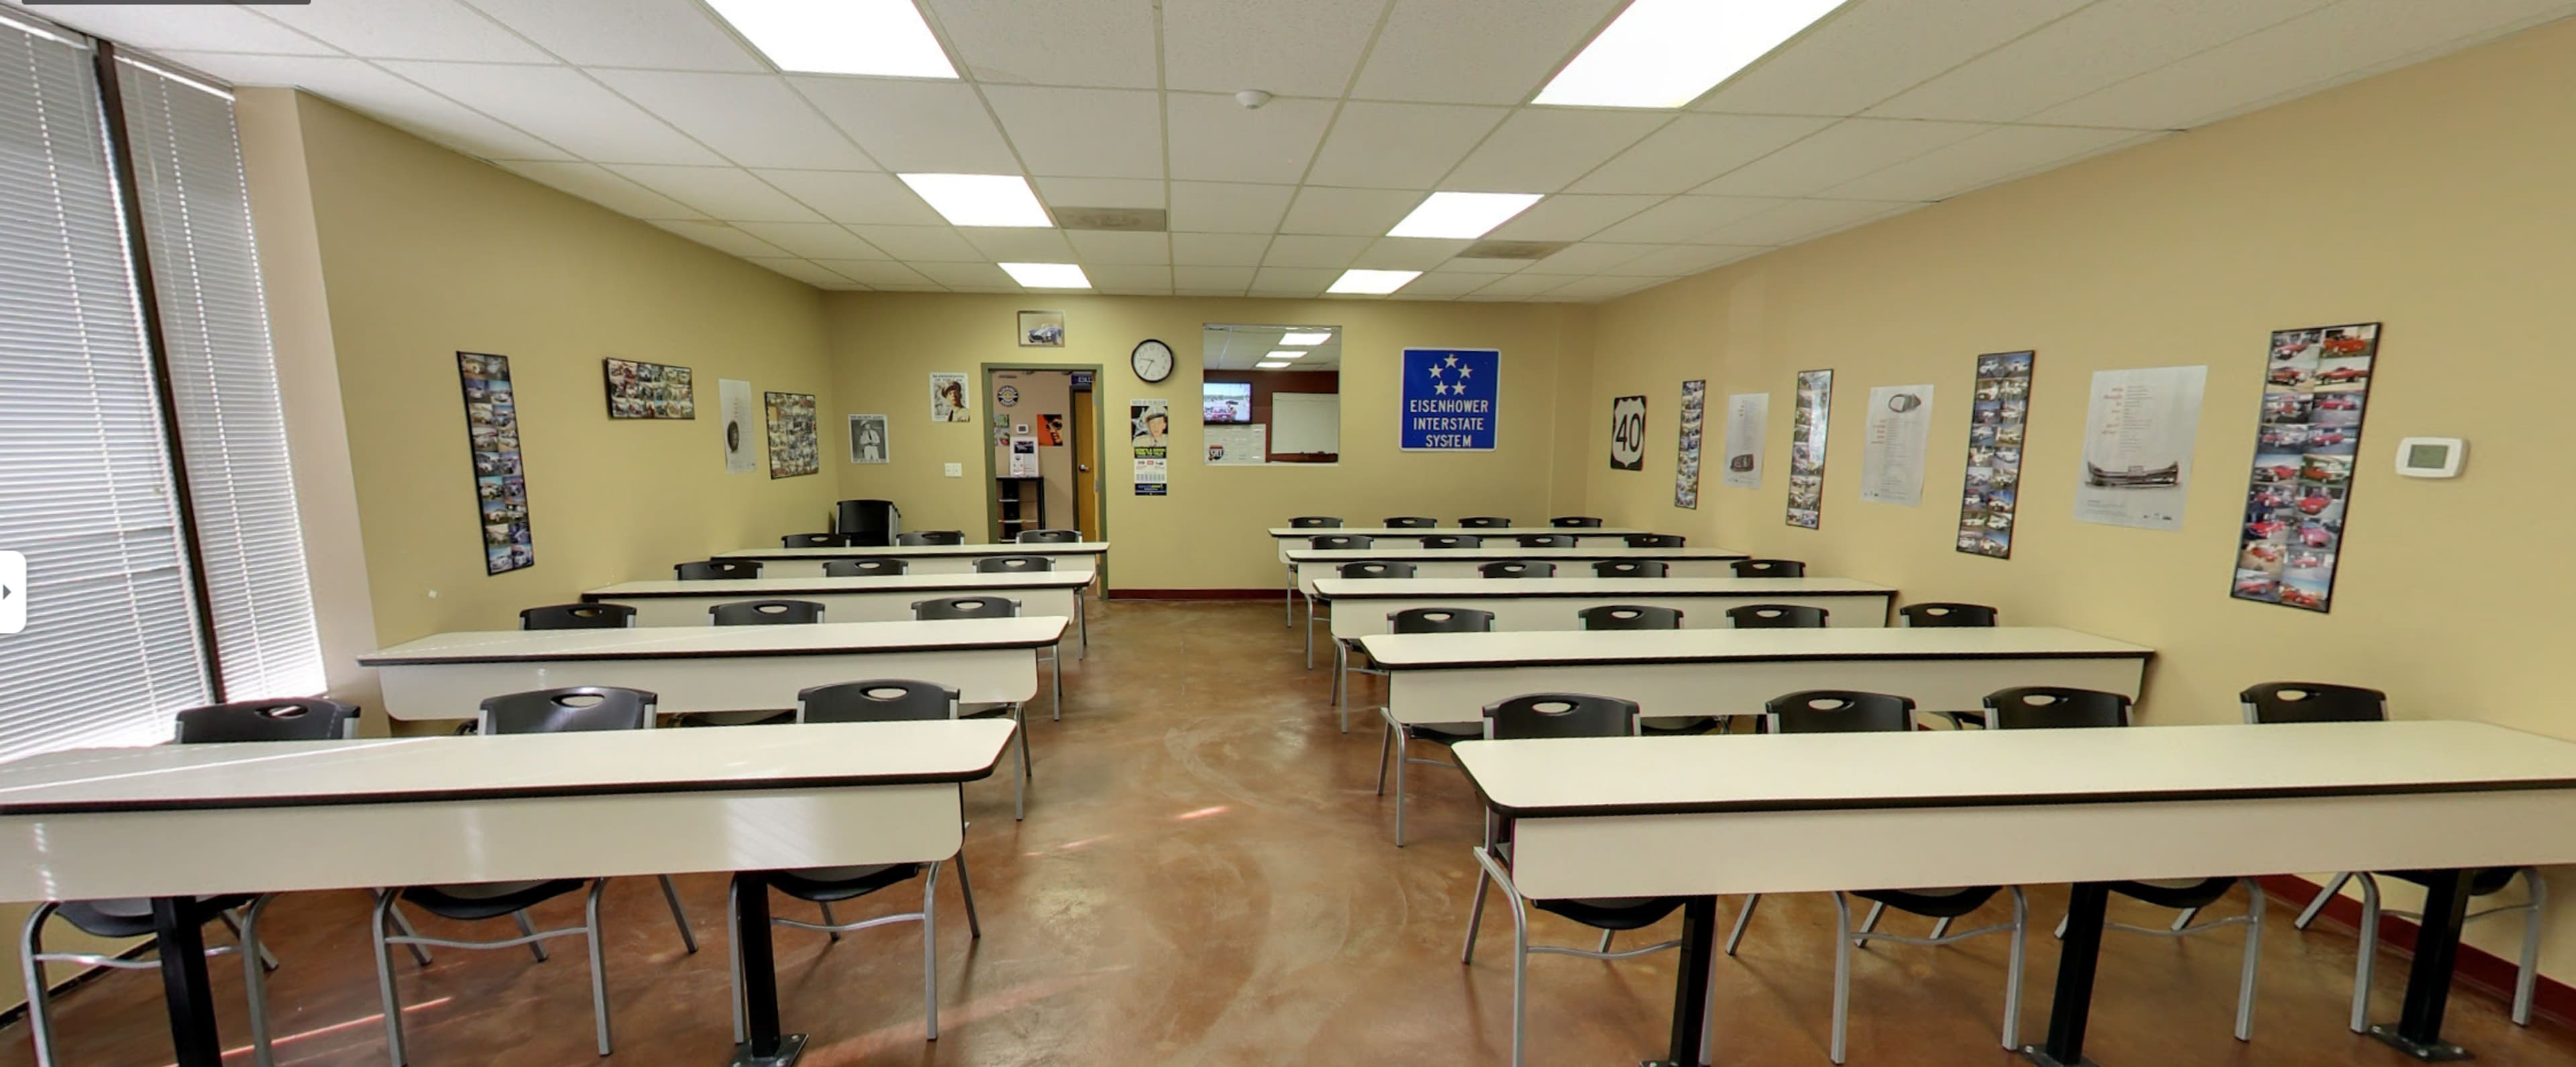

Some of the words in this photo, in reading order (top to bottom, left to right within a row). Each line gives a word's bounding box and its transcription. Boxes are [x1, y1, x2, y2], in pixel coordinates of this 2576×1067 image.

[1410, 400, 1489, 413] EISENHOWER
[1413, 417, 1484, 431] INTERSTATE
[1615, 412, 1641, 453] 40
[1426, 434, 1472, 447] SYSTEM
